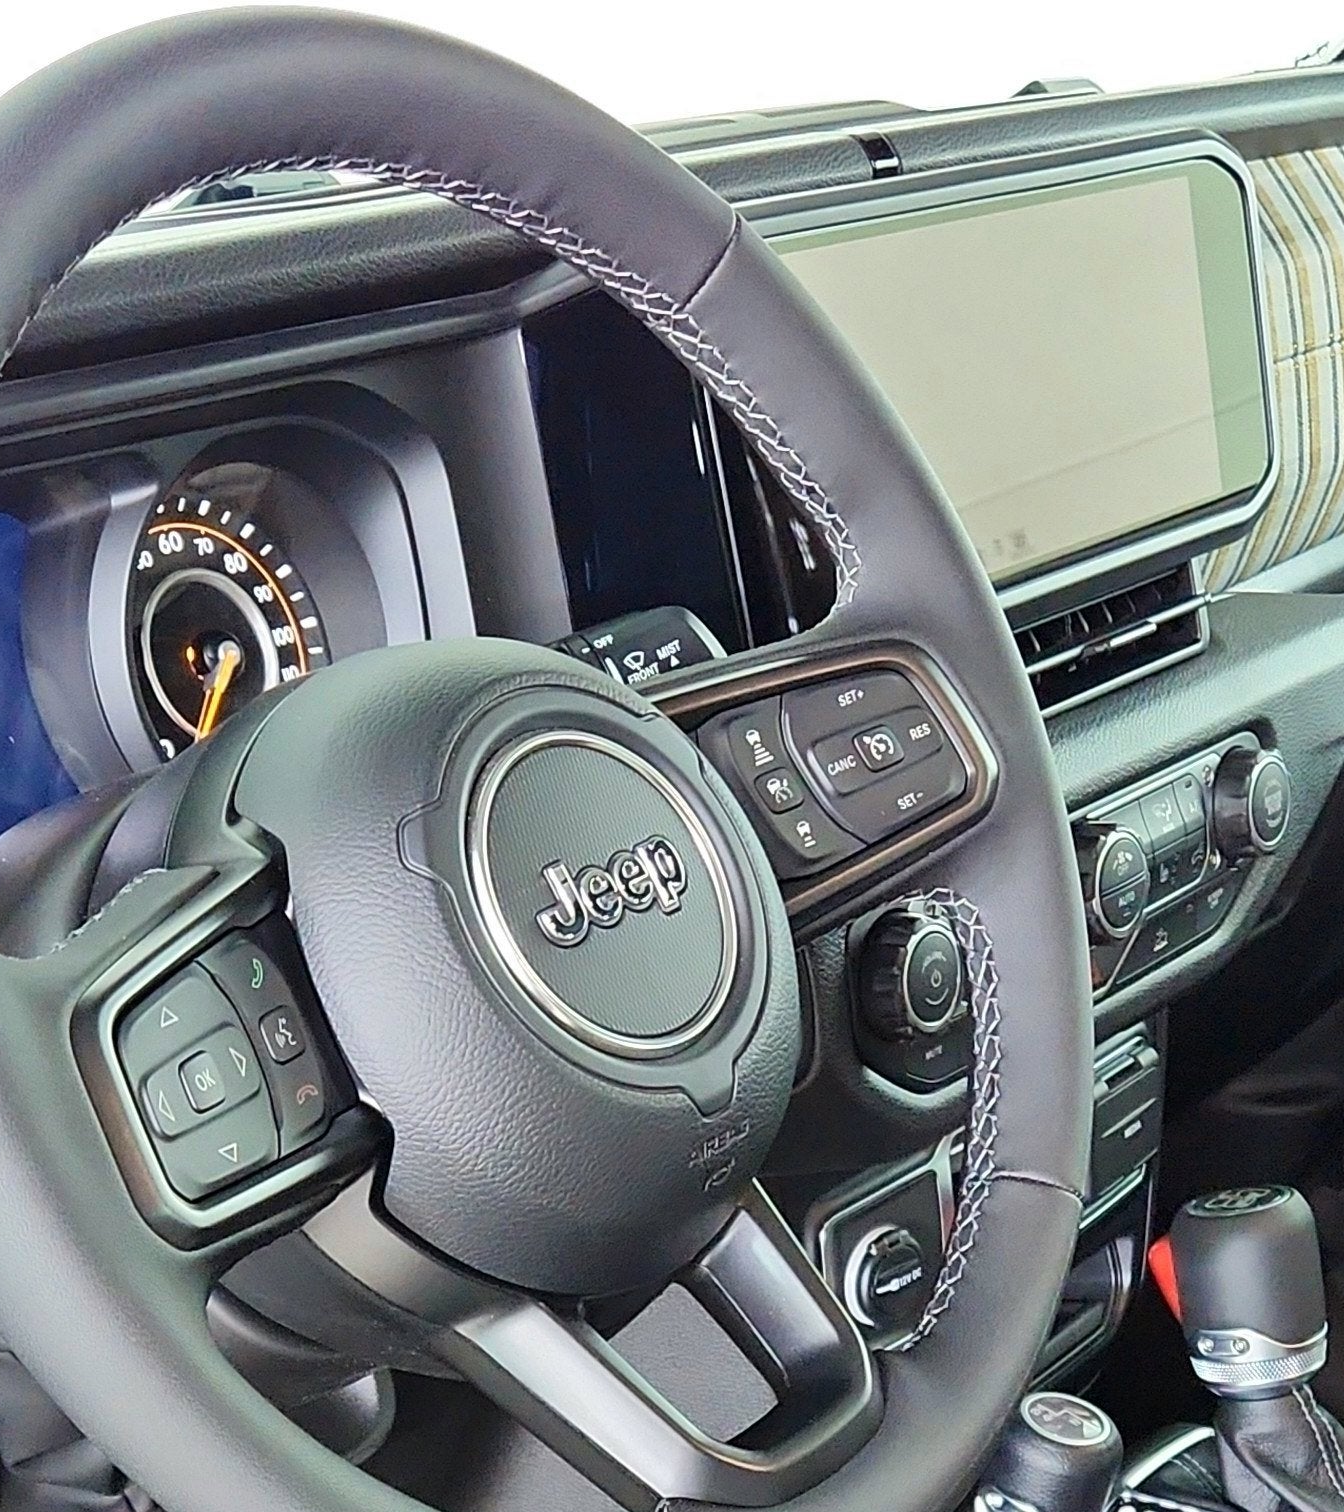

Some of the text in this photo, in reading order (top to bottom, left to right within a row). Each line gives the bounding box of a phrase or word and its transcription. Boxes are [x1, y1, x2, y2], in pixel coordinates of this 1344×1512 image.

[137, 550, 154, 570] 0
[158, 531, 183, 555] 60
[192, 537, 214, 556] 70
[223, 551, 248, 575] 80
[253, 584, 273, 604] 90
[271, 625, 295, 647] 100
[593, 634, 614, 649] OFF
[656, 639, 681, 661] MIST
[627, 662, 660, 685] FRONT
[909, 723, 931, 741] RES
[827, 754, 856, 776] CANC
[535, 834, 689, 949] Jeep
[194, 1067, 217, 1092] OK
